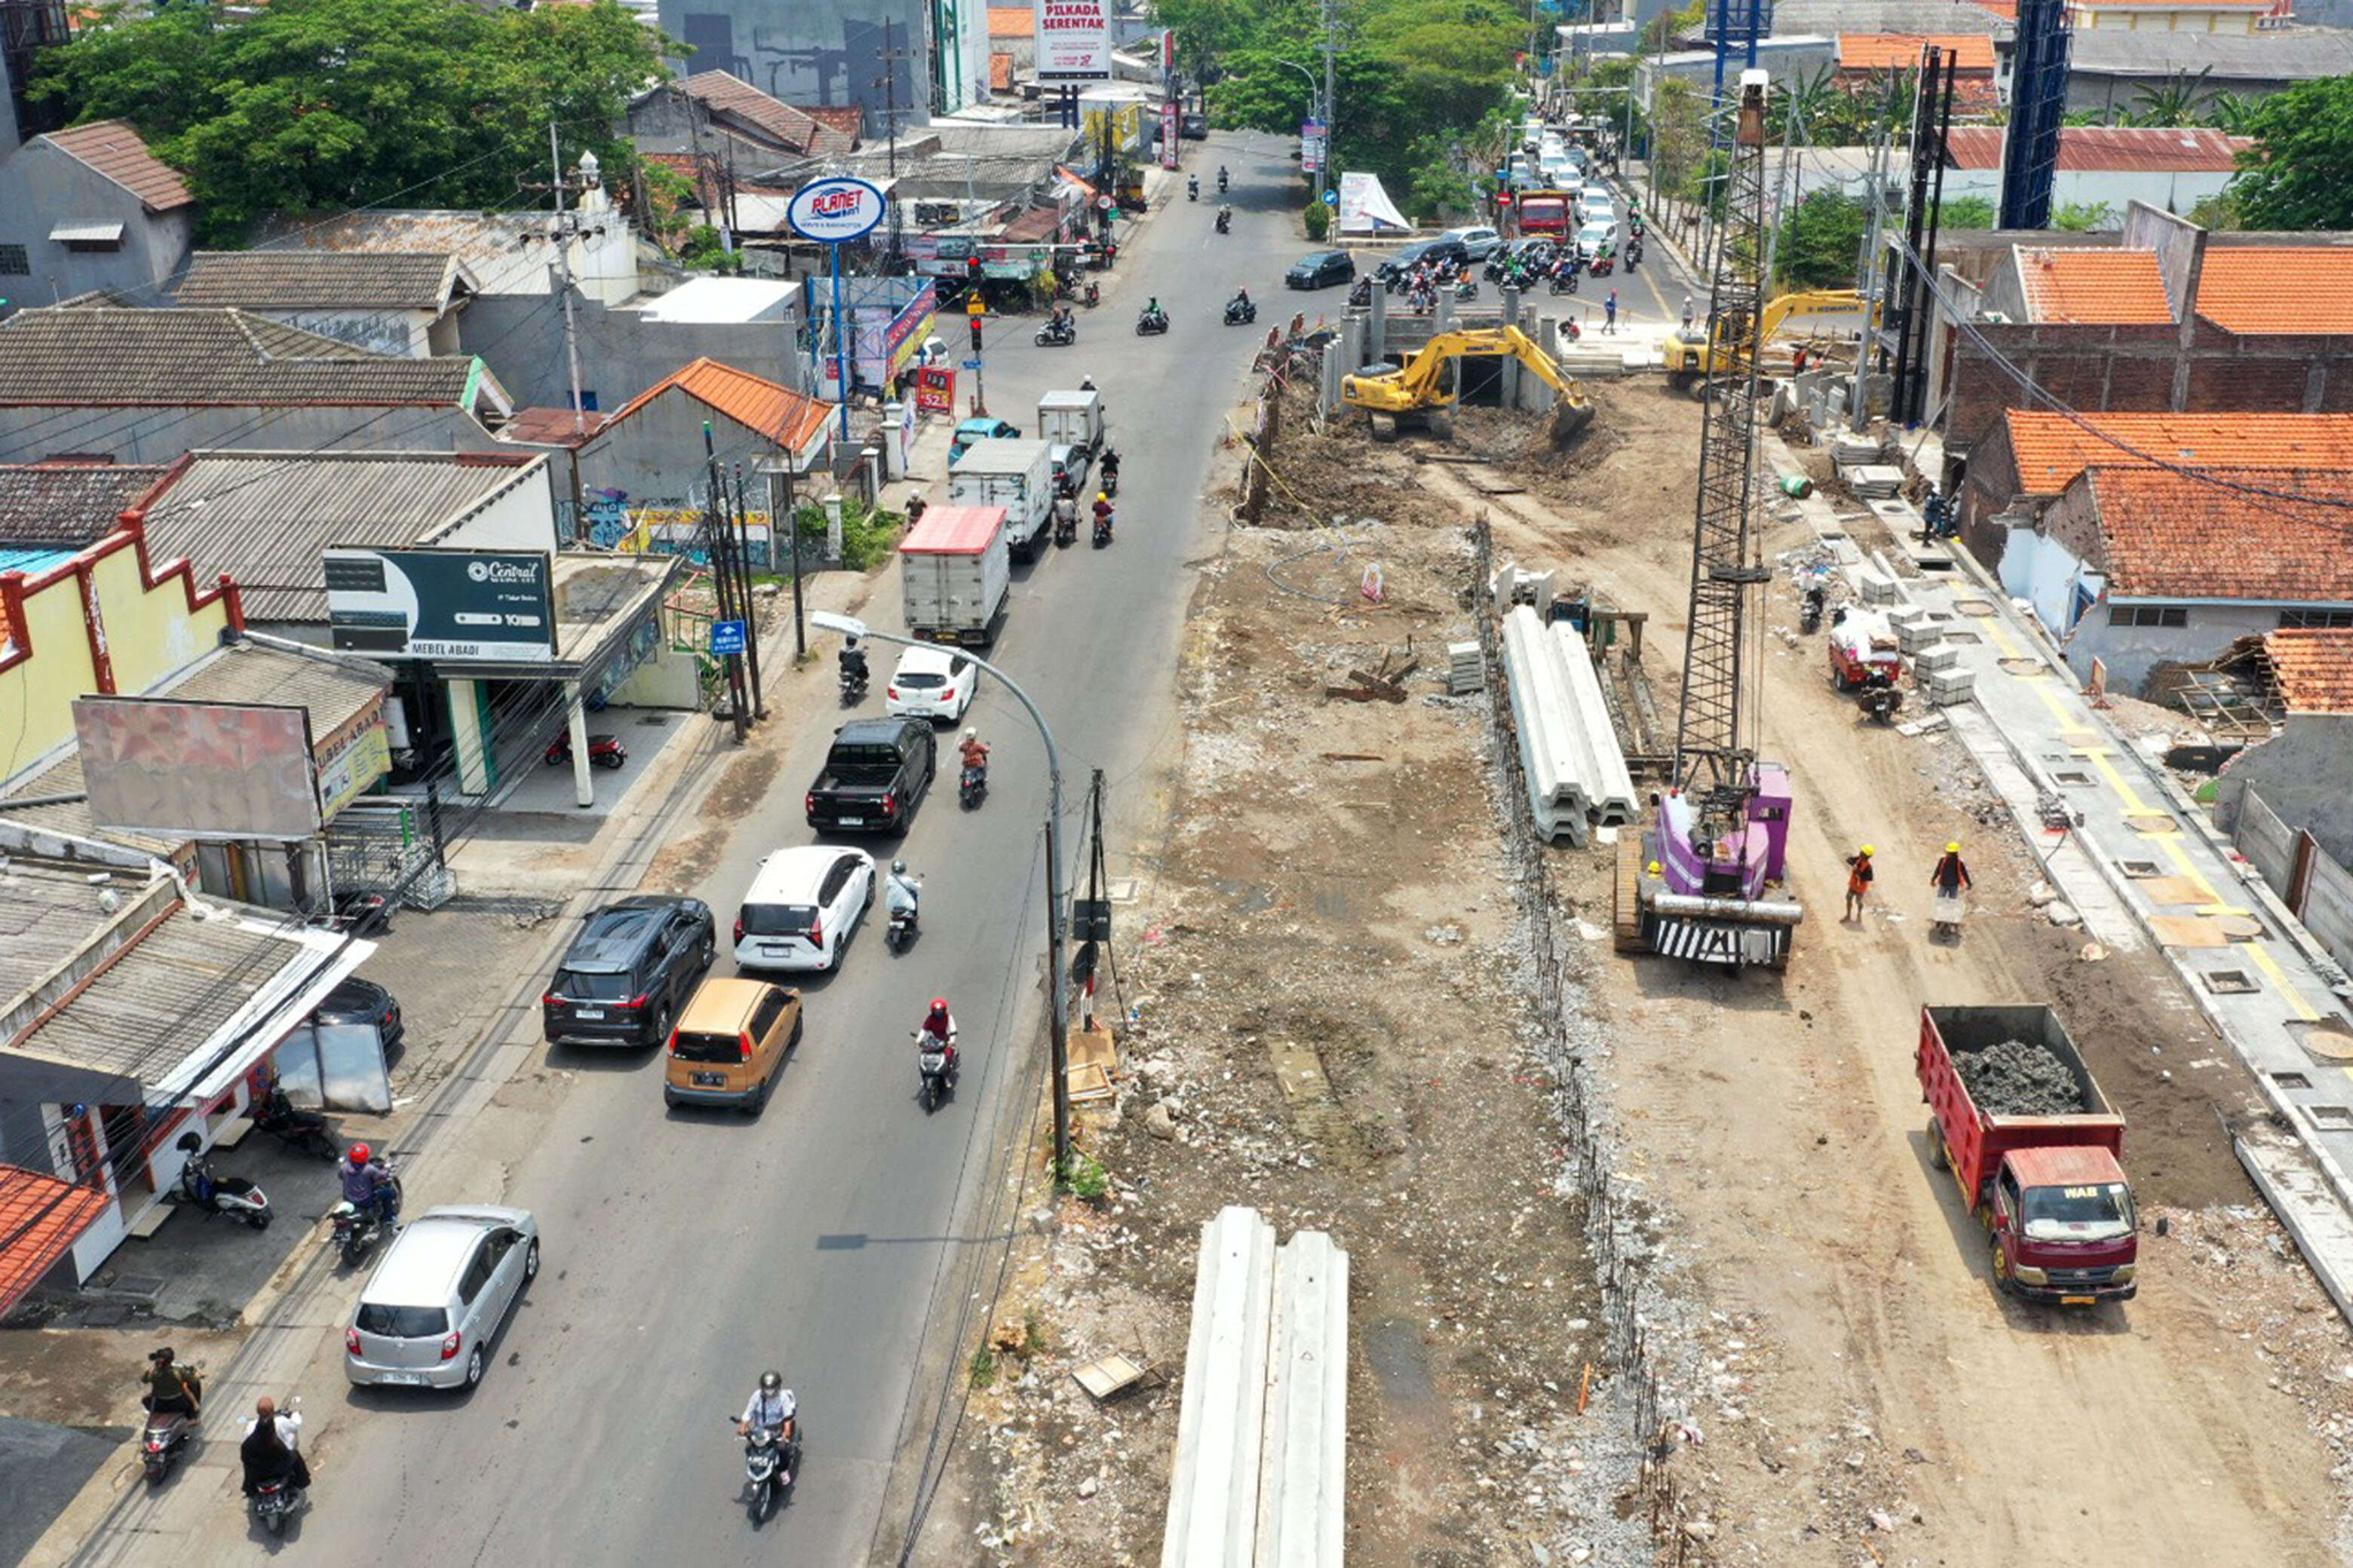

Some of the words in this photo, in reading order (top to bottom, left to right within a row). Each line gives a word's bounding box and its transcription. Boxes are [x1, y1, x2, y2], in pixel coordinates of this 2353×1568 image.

[1045, 5, 1100, 16] PILKADA
[1042, 18, 1104, 29] SERENTAK
[812, 189, 864, 215] PLANET
[489, 561, 538, 578] Central
[412, 643, 446, 655] MEBEL
[448, 645, 479, 655] ABADI
[2063, 1186, 2098, 1199] WAB
